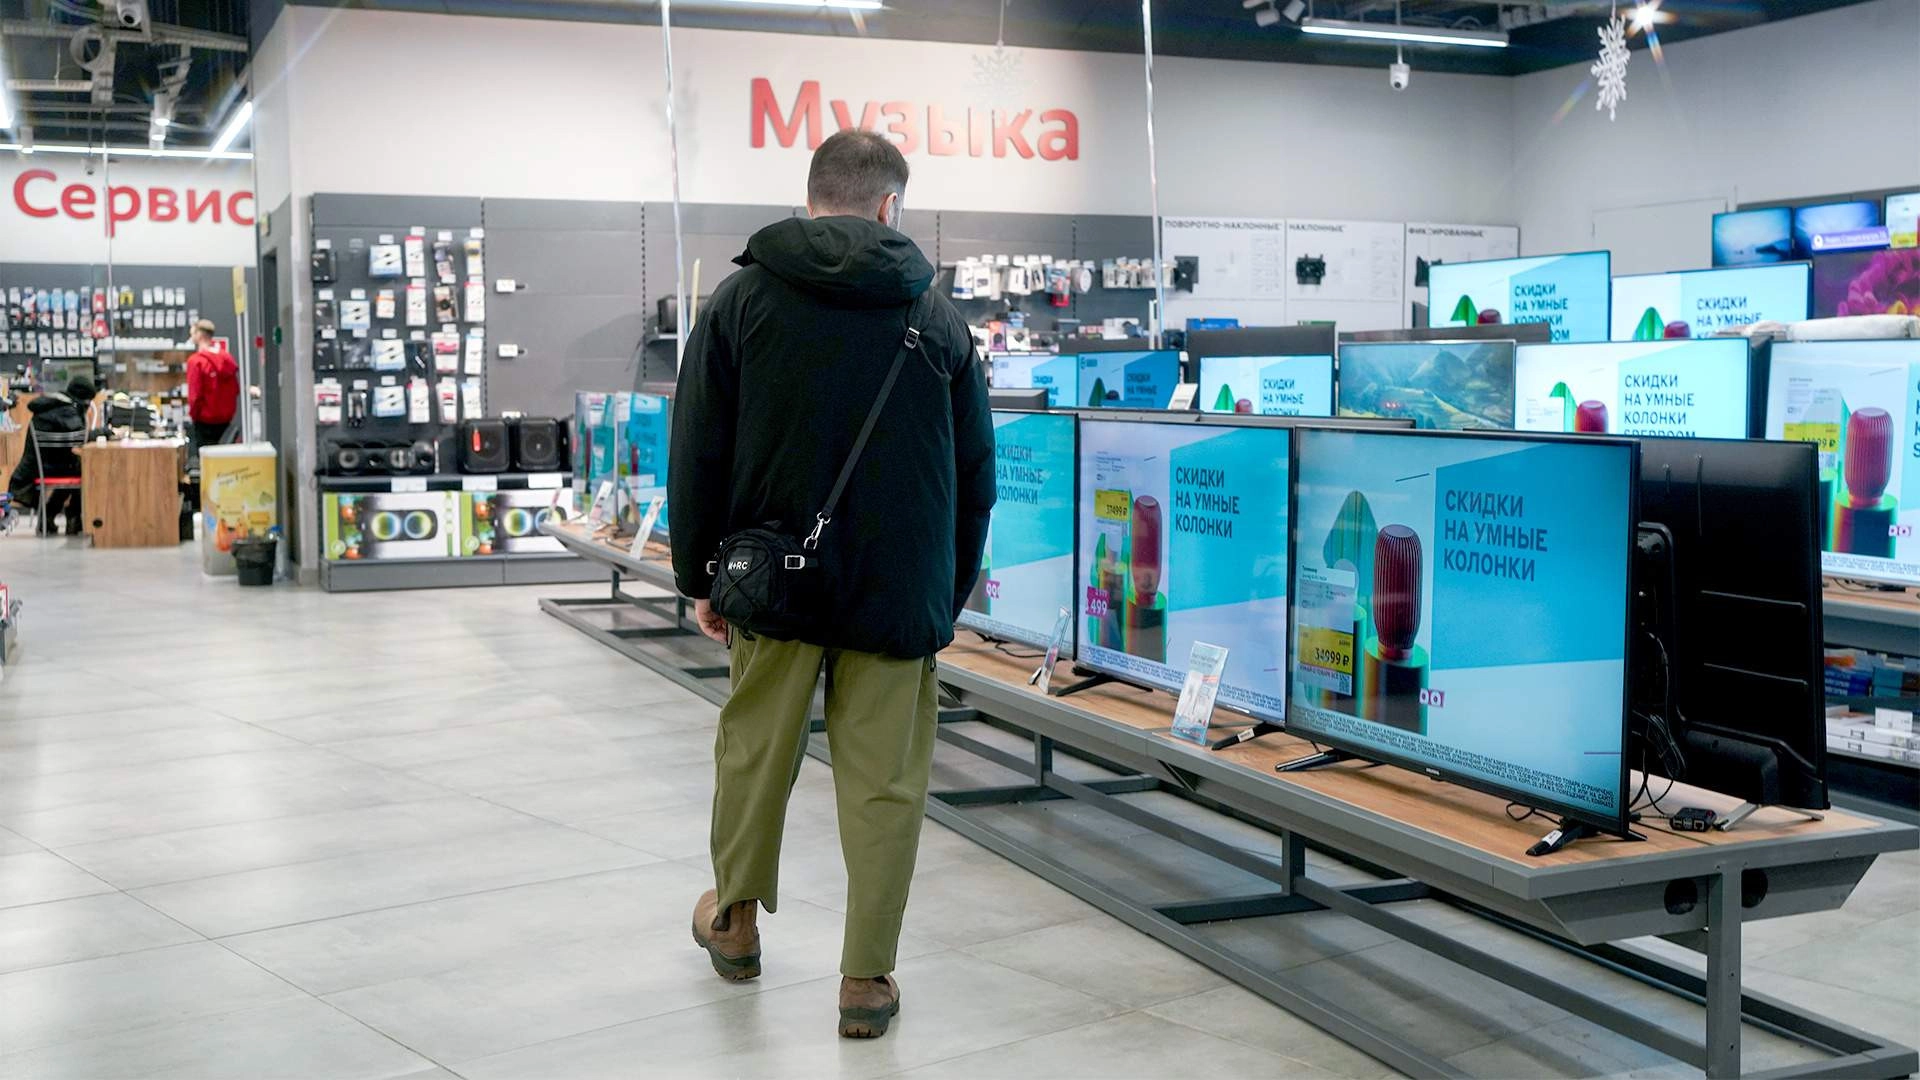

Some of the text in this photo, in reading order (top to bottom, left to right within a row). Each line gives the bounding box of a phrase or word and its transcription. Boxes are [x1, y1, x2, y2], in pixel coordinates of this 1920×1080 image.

[13, 168, 255, 238] Сервис
[1515, 284, 1556, 297] СКИДКИ
[1515, 298, 1568, 311] НА УМНЫЕ
[1697, 296, 1747, 311] СКИДКИ
[1697, 314, 1713, 326] НА
[1263, 379, 1295, 390] СКИДКИ
[1625, 374, 1678, 390] СКИДКИ
[1263, 393, 1304, 405] НА УМНЫЕ
[1624, 392, 1695, 407] НА УМНЫЕ
[1624, 411, 1686, 425] КОЛОНКИ
[997, 444, 1032, 464] СКИДКИ
[997, 463, 1043, 484] НА УМНЫЕ
[1176, 466, 1225, 490] СКИДКИ
[1176, 489, 1240, 515] НА УМНЫЕ
[1445, 489, 1524, 520] СКИДКИ
[1175, 513, 1233, 539] КОЛОНКИ
[1444, 518, 1548, 552] НА УМНЫЕ
[1443, 547, 1536, 582] КОЛОНКИ
